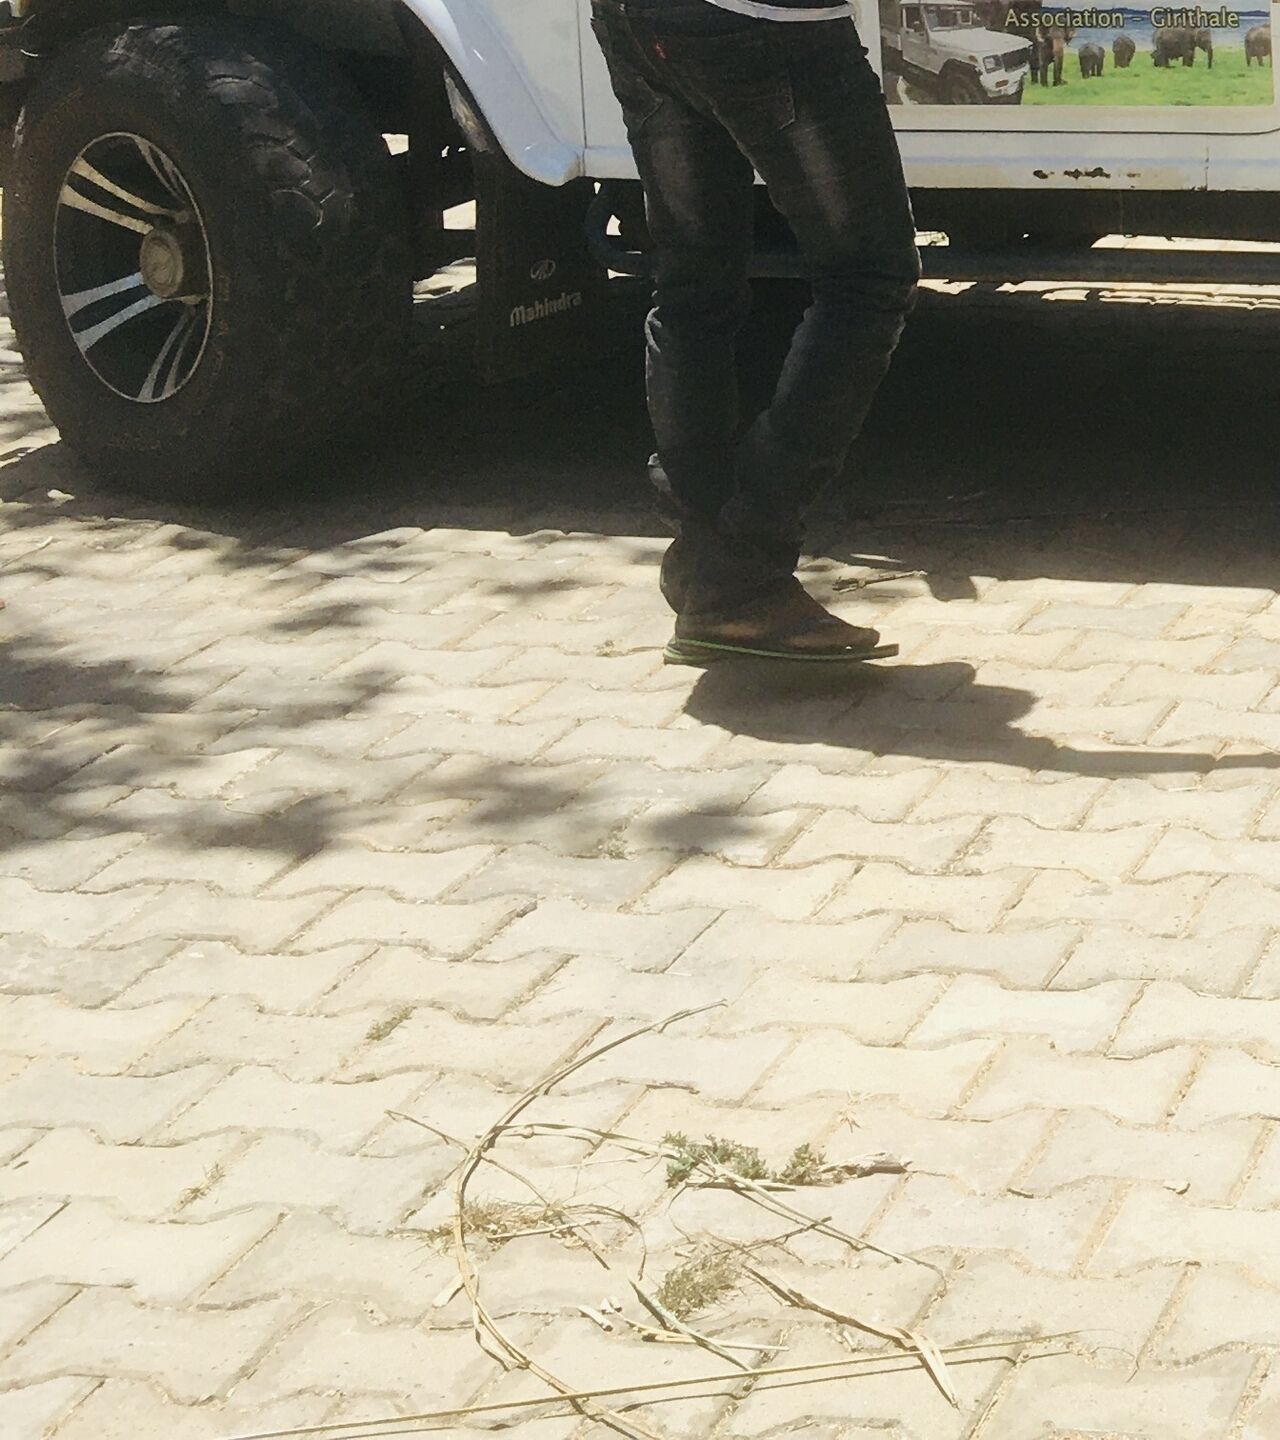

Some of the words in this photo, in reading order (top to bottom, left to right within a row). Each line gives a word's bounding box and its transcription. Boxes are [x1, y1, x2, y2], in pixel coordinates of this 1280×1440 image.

[1004, 8, 1125, 28] Association
[1150, 6, 1239, 28] Girithale
[509, 291, 582, 327] Mahindra
